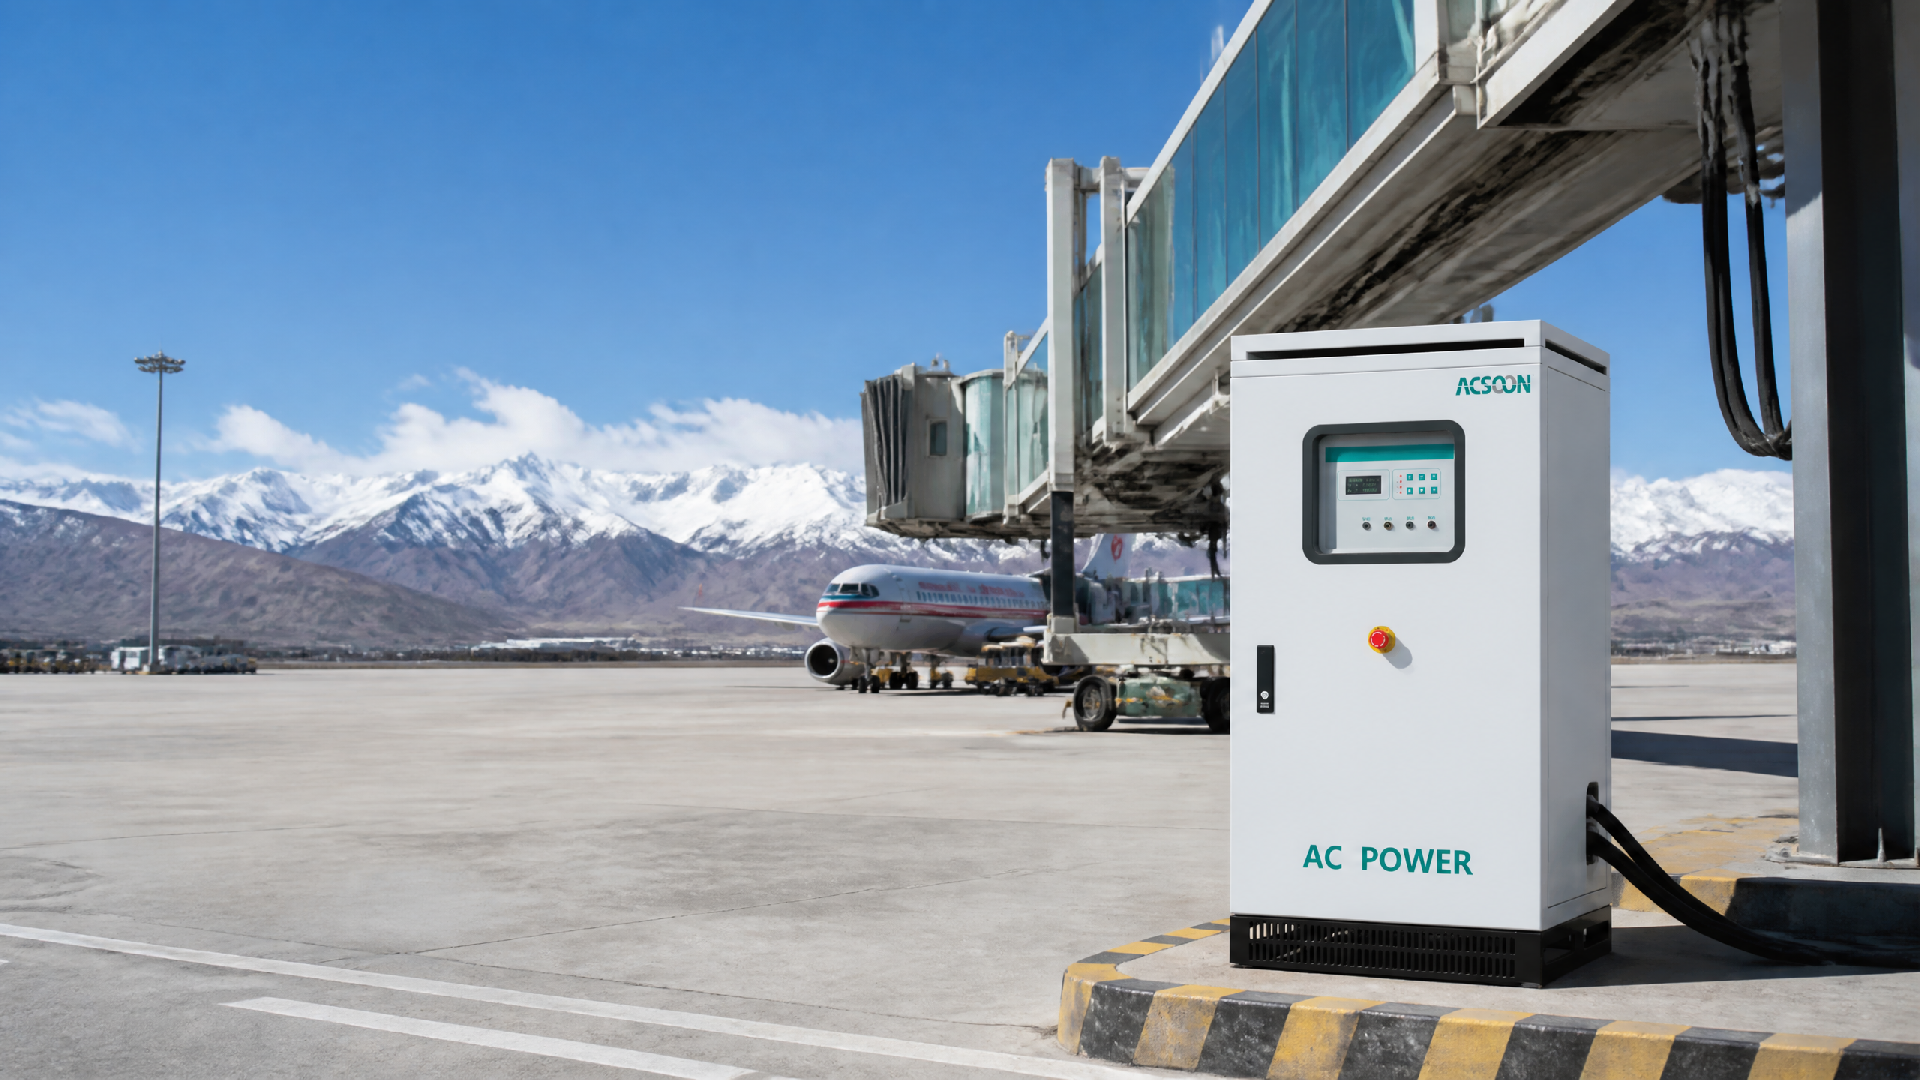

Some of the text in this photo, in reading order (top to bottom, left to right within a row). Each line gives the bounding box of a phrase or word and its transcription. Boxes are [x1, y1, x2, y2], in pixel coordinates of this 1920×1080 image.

[1455, 375, 1531, 396] ACSOON
[1303, 844, 1474, 875] AC POWER
